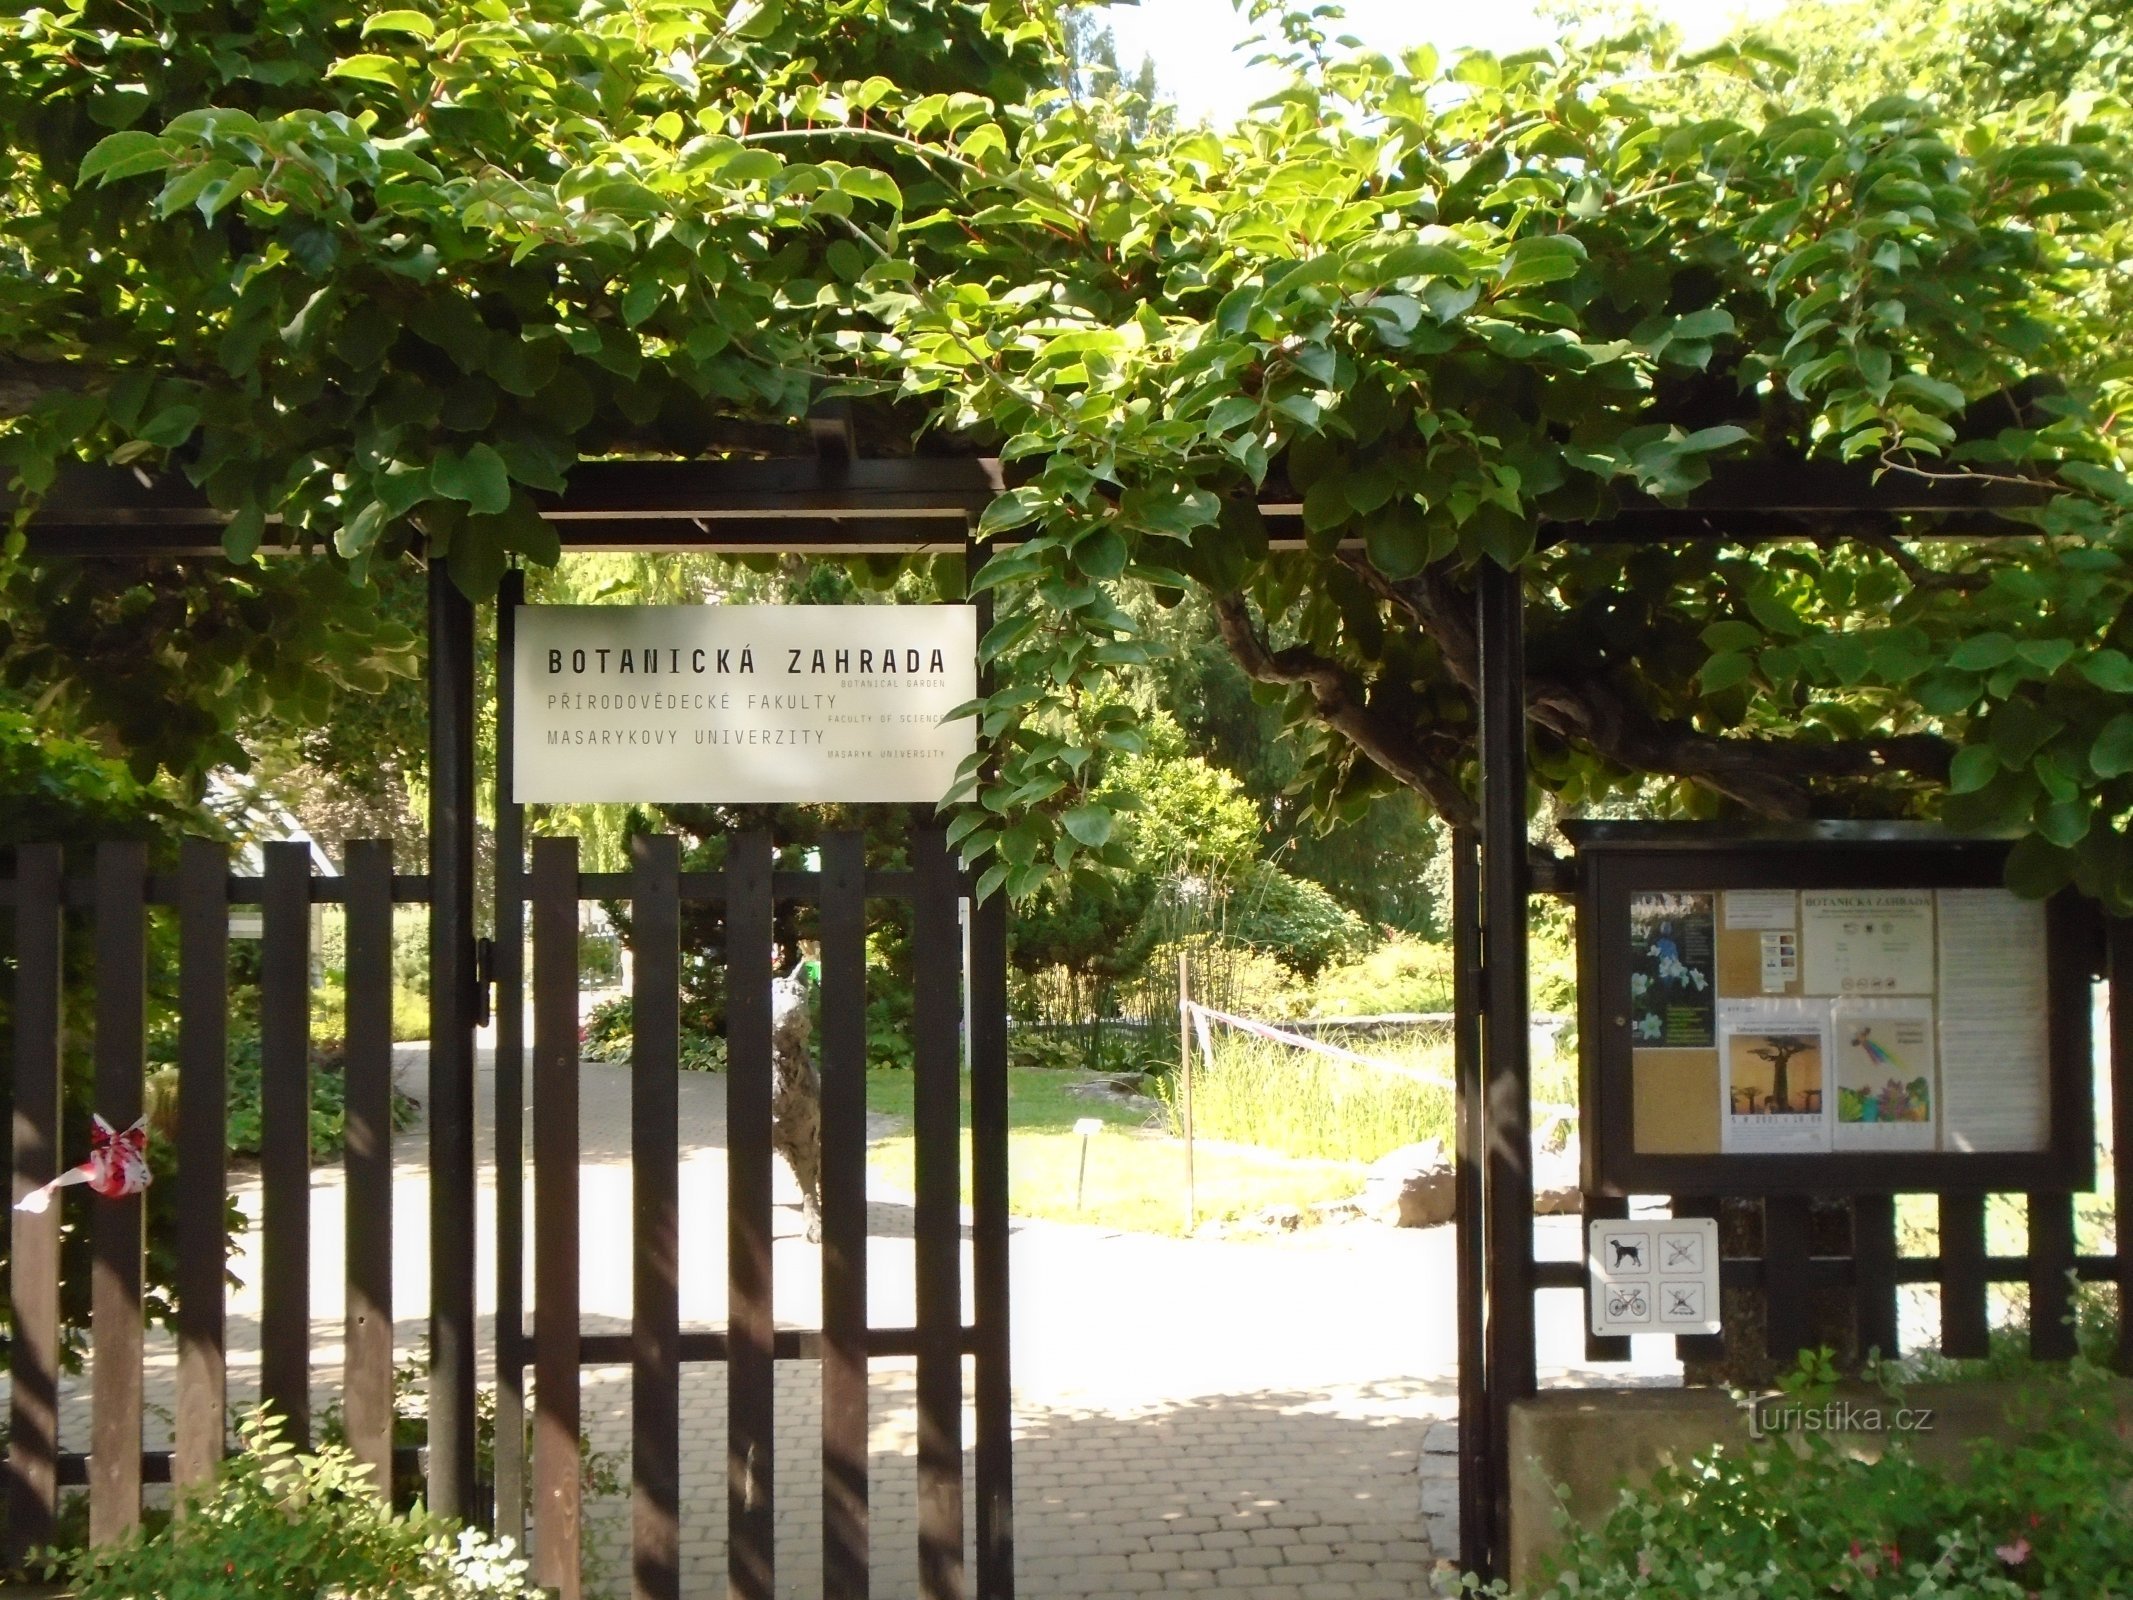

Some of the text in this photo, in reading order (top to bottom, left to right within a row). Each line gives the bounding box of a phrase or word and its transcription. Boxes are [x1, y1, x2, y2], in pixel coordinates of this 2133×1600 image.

[548, 643, 946, 674] BOTANICKÁ ZAHRADA
[840, 679, 946, 688] BOTANICAL GARDEN
[547, 692, 836, 710] PŘÍRODOVĚDECKÉ FAKULTY
[827, 714, 873, 723] FACULTY
[879, 714, 893, 723] OF
[547, 730, 824, 745] MASARYKOVY UNIVERZITY
[827, 750, 946, 759] MASARYK UNIVERSITY
